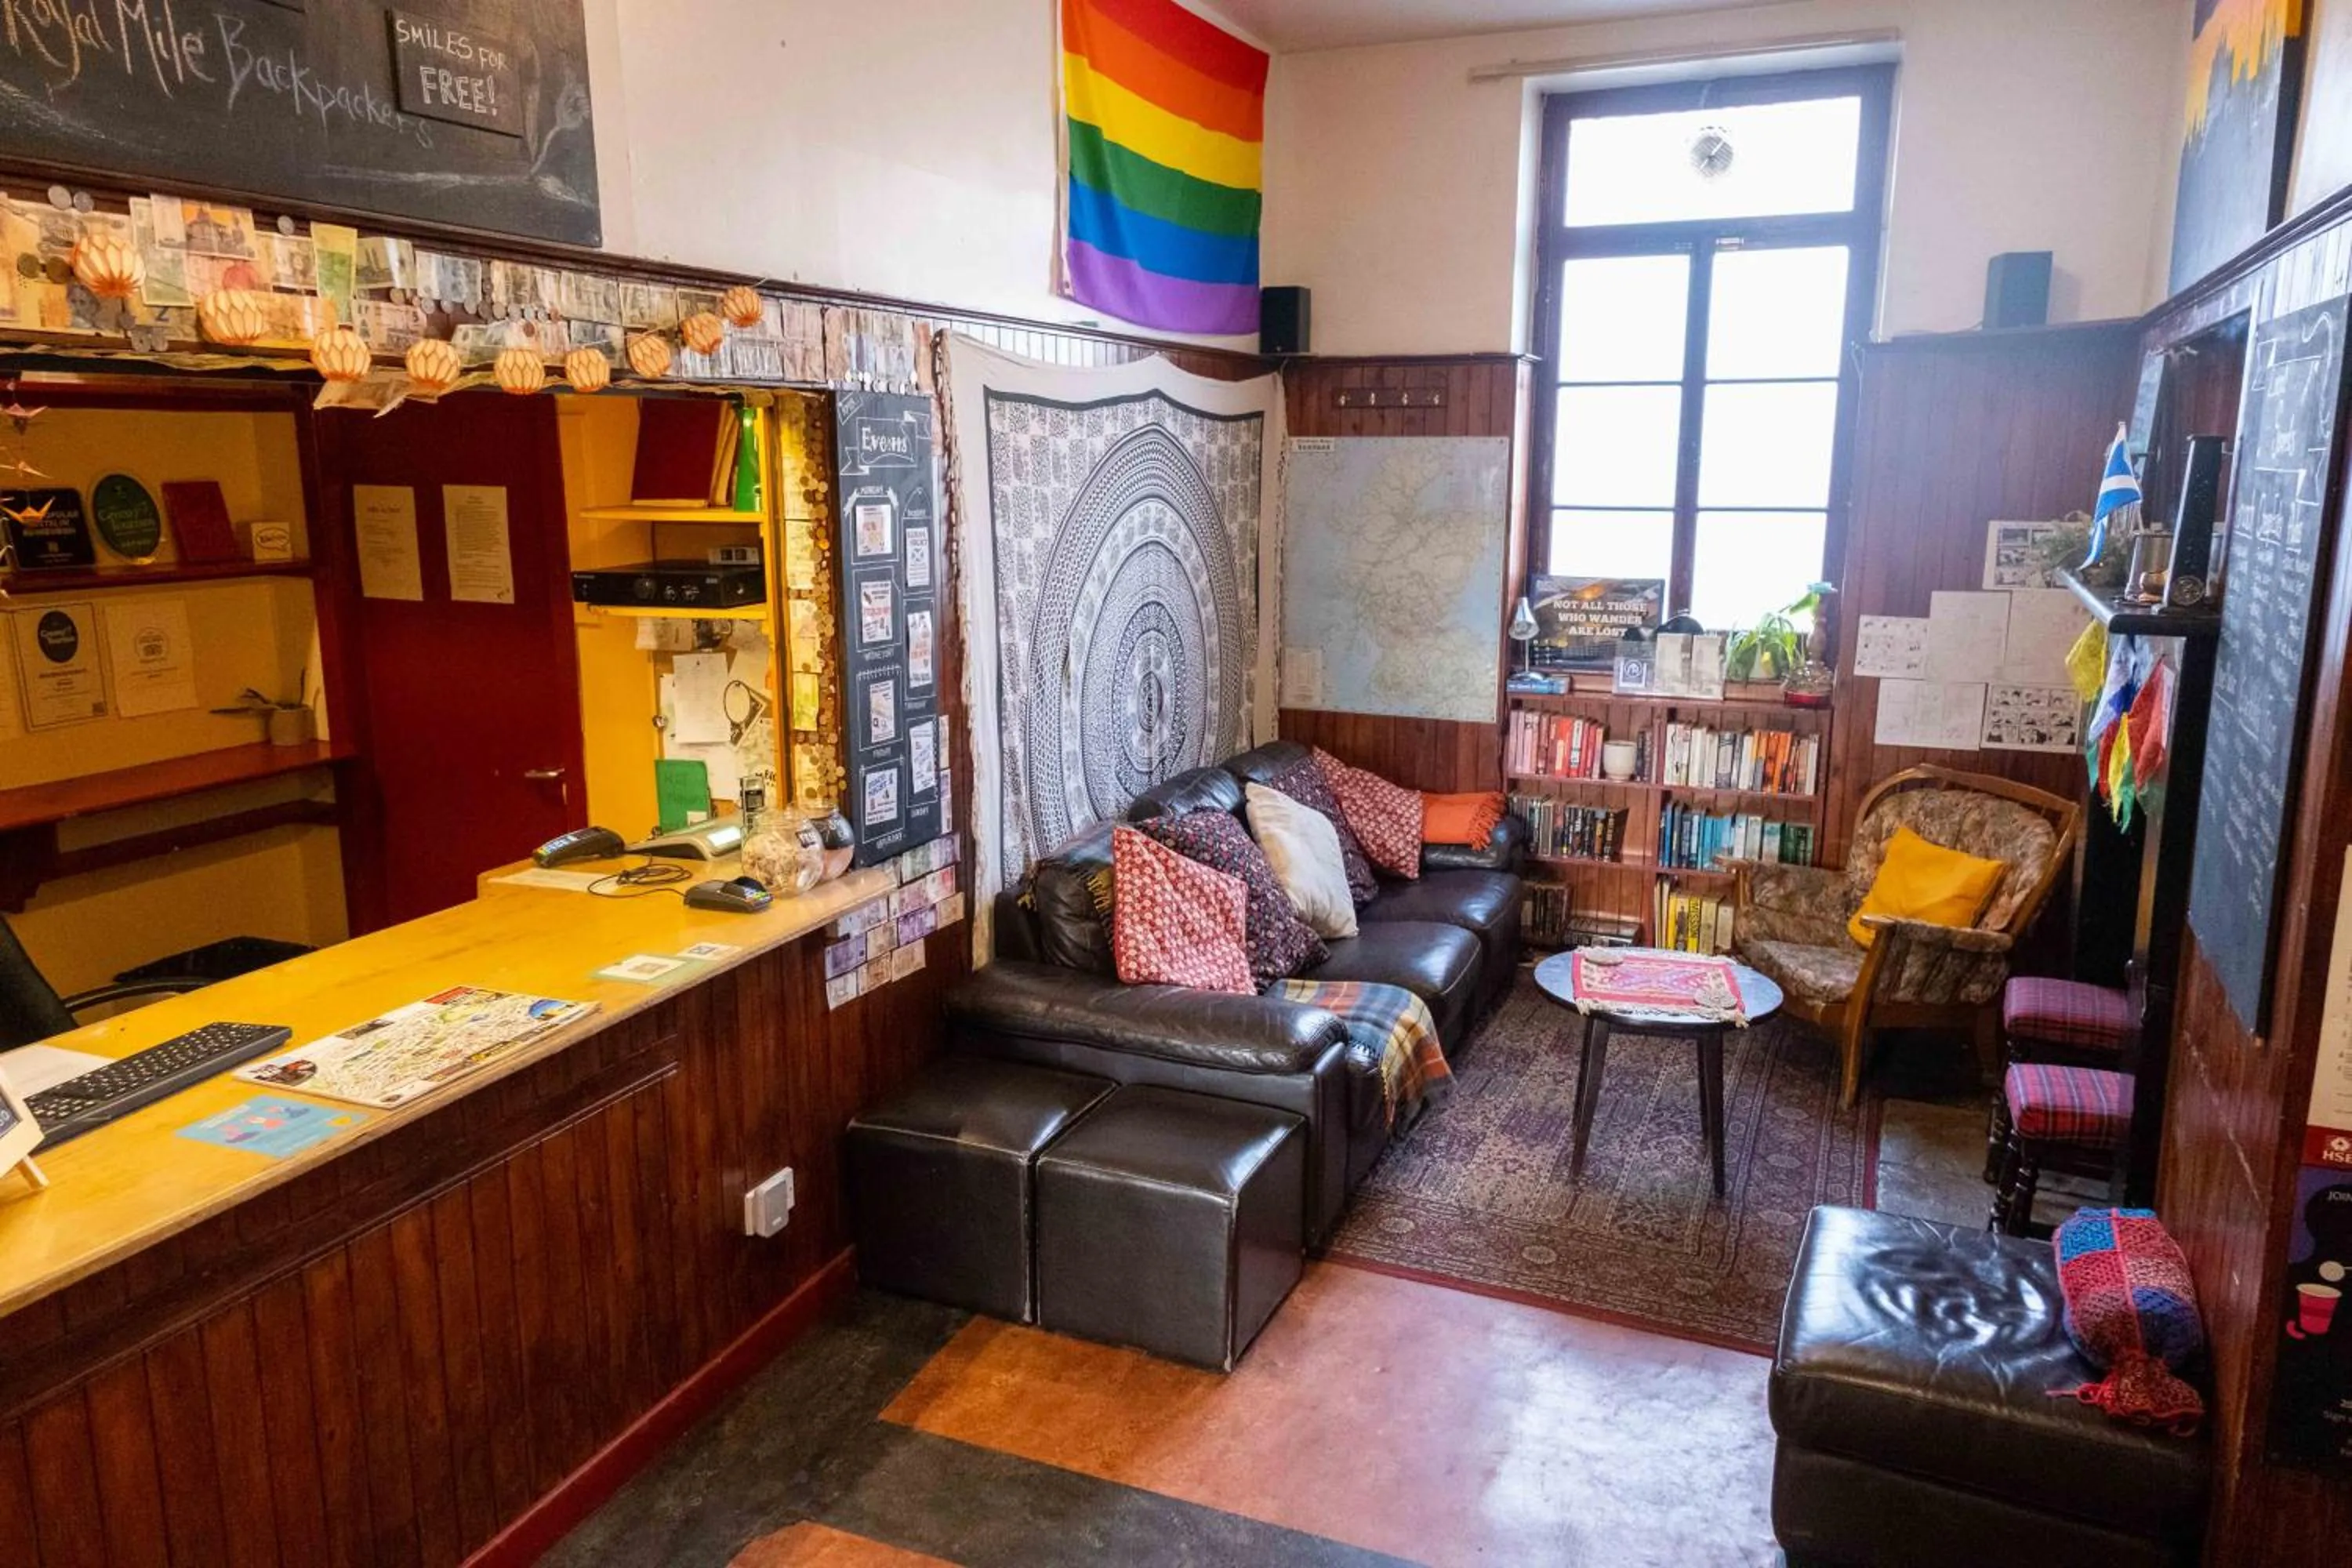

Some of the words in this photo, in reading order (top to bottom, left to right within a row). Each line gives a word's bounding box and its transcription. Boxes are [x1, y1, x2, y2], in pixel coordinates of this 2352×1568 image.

[117, 0, 216, 100] Mile
[395, 19, 474, 60] SMILES
[478, 47, 510, 71] FOR
[419, 65, 500, 116] FREE!
[861, 426, 908, 453] Events
[1553, 600, 1579, 609] NOT
[1581, 601, 1605, 610] ALL
[1606, 601, 1647, 612] THOSE
[1558, 612, 1587, 622] WHO
[1589, 614, 1643, 625] WANDER
[1569, 625, 1595, 635] ARE
[1595, 626, 1628, 637] LOST
